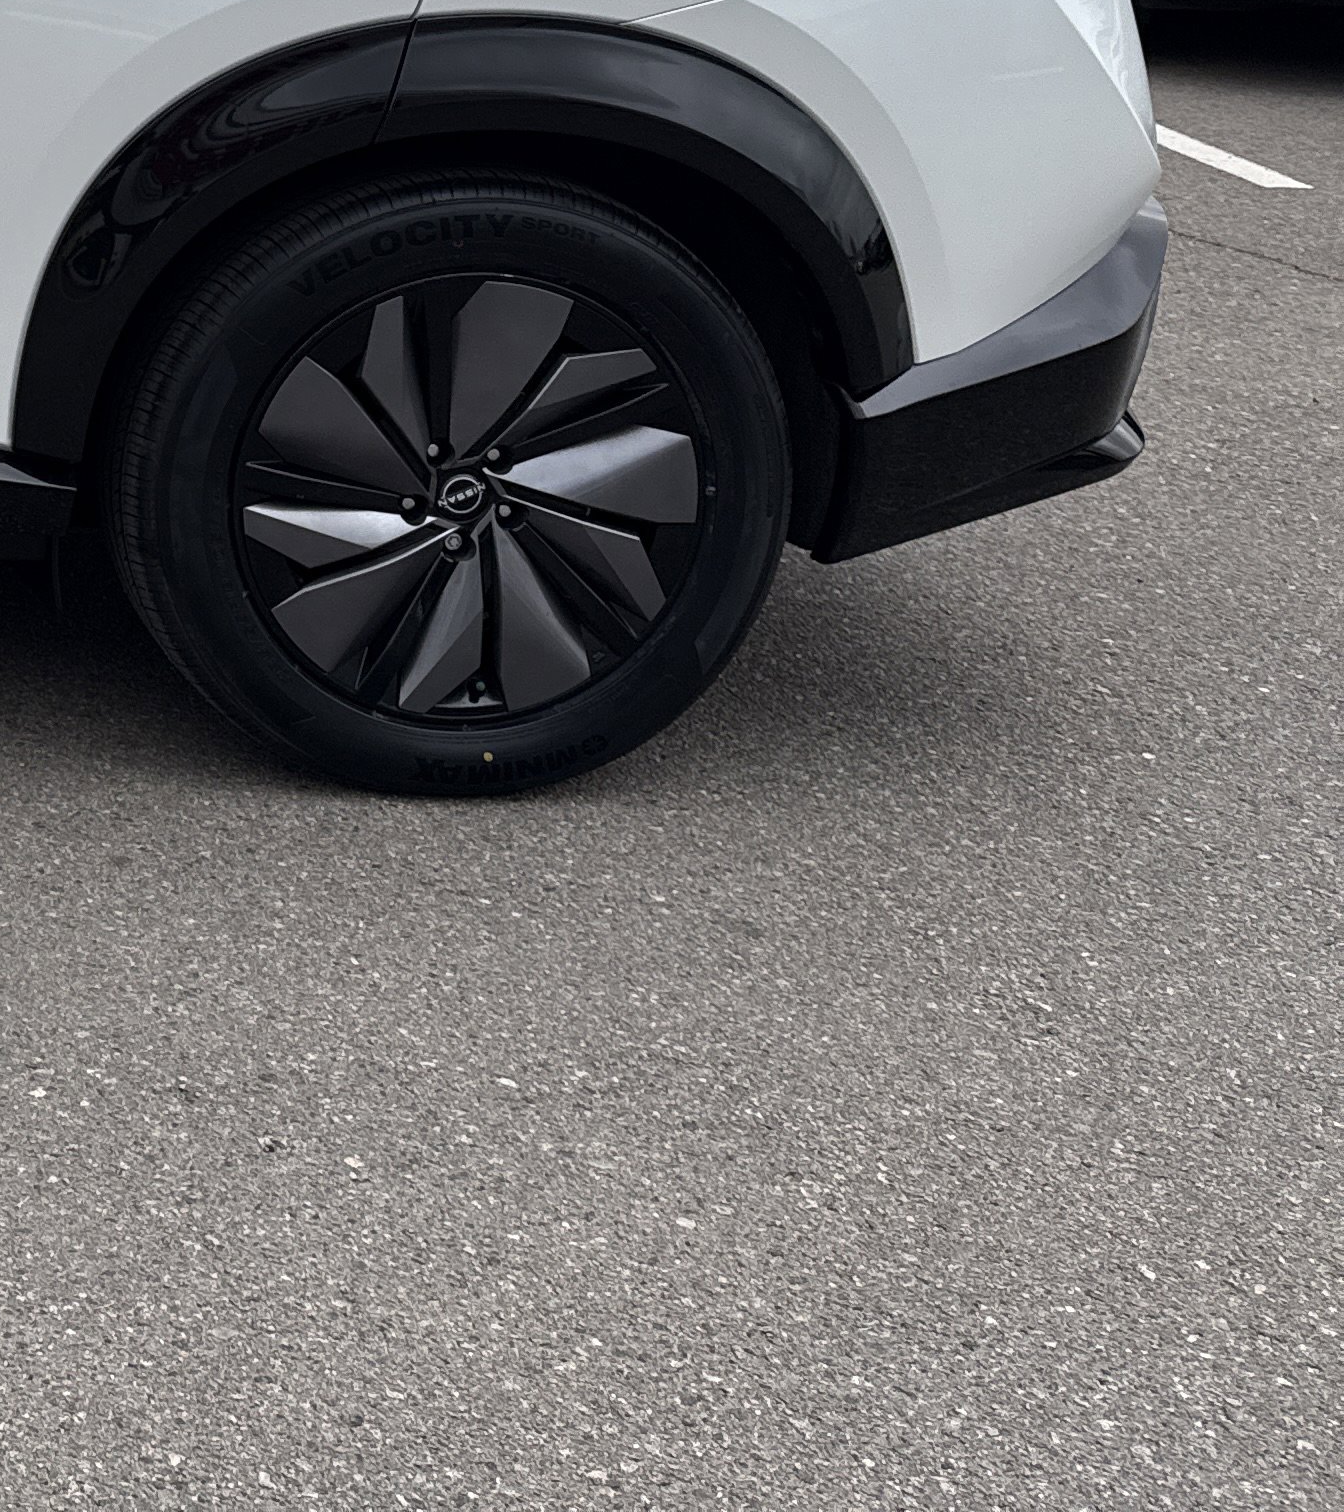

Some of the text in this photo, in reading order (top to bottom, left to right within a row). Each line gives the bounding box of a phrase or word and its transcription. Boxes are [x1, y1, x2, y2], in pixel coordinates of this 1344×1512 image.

[287, 213, 602, 298] VELOCITY SPORT
[437, 482, 487, 507] NISSAN
